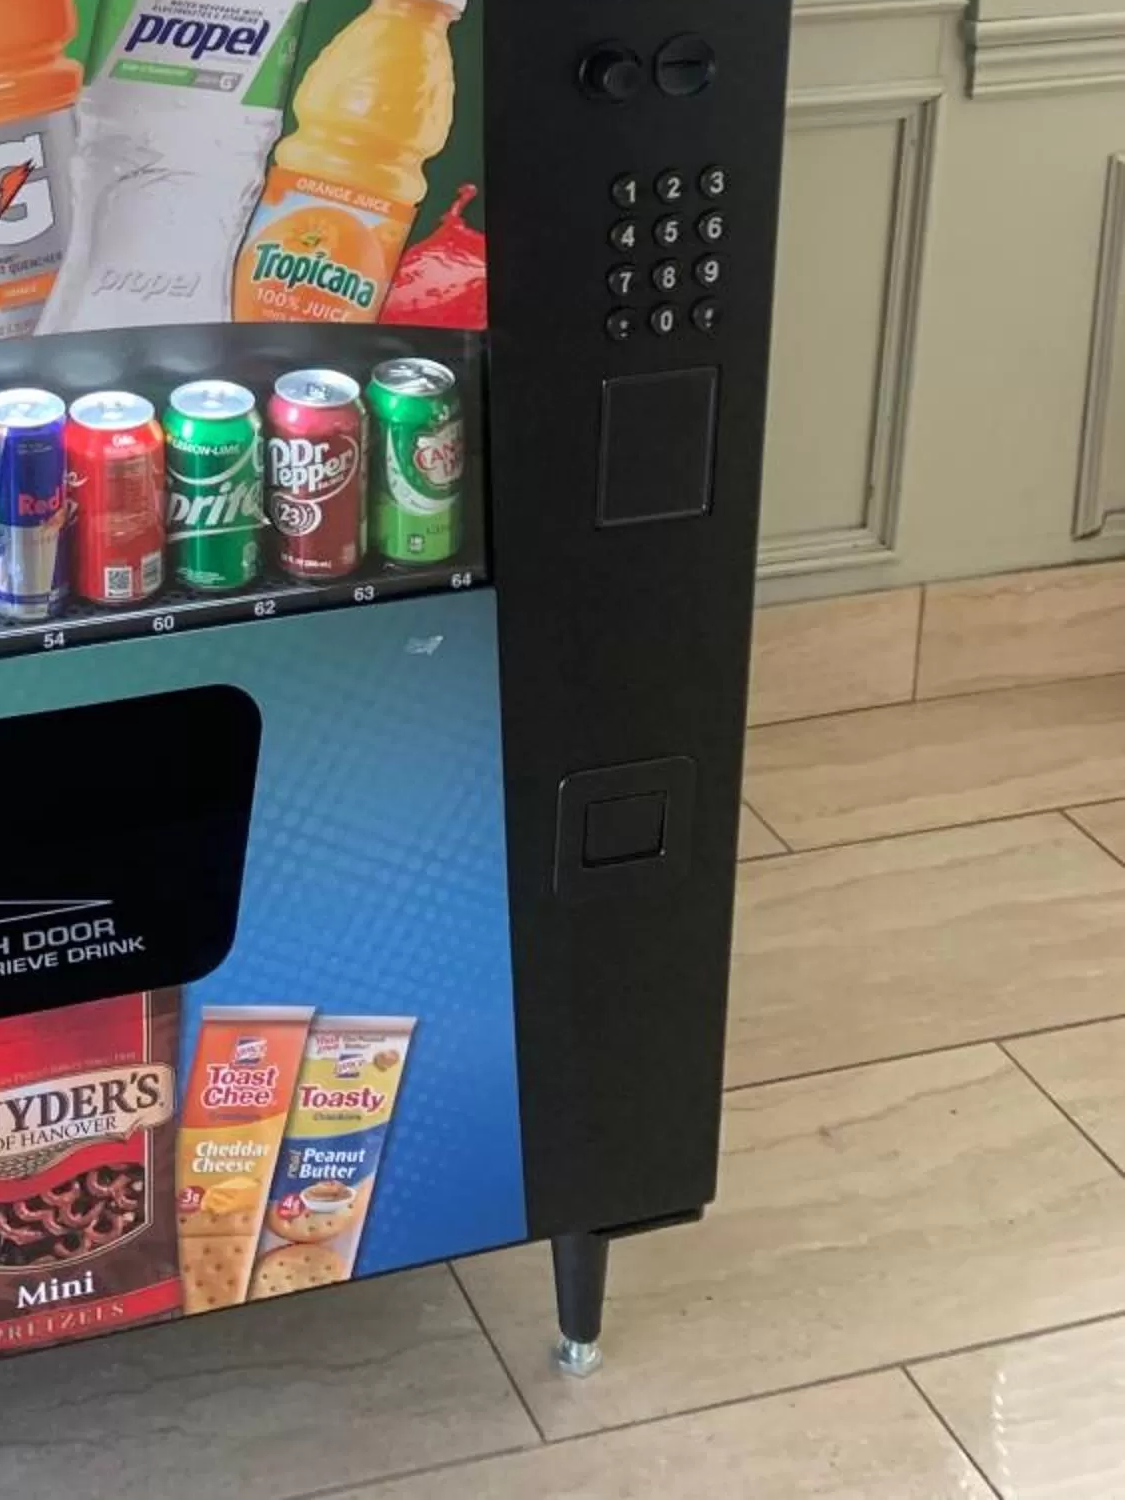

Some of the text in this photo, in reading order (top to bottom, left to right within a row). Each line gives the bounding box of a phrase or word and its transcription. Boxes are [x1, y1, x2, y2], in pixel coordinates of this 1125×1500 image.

[123, 12, 271, 61] propel
[626, 180, 636, 203] 1
[666, 176, 681, 199] 2
[709, 170, 724, 194] 3
[295, 177, 392, 214] ORANGE JUICE
[620, 224, 635, 247] 4
[663, 220, 679, 243] 5
[707, 216, 723, 239] 6
[252, 243, 375, 309] Tropicana
[619, 271, 633, 293] 7
[662, 265, 676, 289] 8
[704, 260, 719, 283] 9
[660, 309, 674, 332] 0
[18, 486, 61, 517] Red
[167, 481, 264, 529] prite
[279, 503, 301, 526] 23
[451, 573, 473, 589] 64
[353, 586, 375, 602] 63
[254, 601, 276, 617] 62
[152, 615, 175, 632] 60
[43, 632, 65, 649] 54
[22, 917, 116, 953] DOOR
[66, 935, 147, 964] DRINK
[207, 1064, 277, 1087] Toast
[202, 1087, 271, 1108] Chee
[299, 1085, 386, 1112] Toasty
[20, 1116, 118, 1148] HANOVER
[195, 1141, 271, 1158] Cheddar
[302, 1147, 366, 1164] Peanut
[191, 1157, 256, 1174] Cheese
[299, 1163, 357, 1179] Butter
[15, 1270, 95, 1309] Mini
